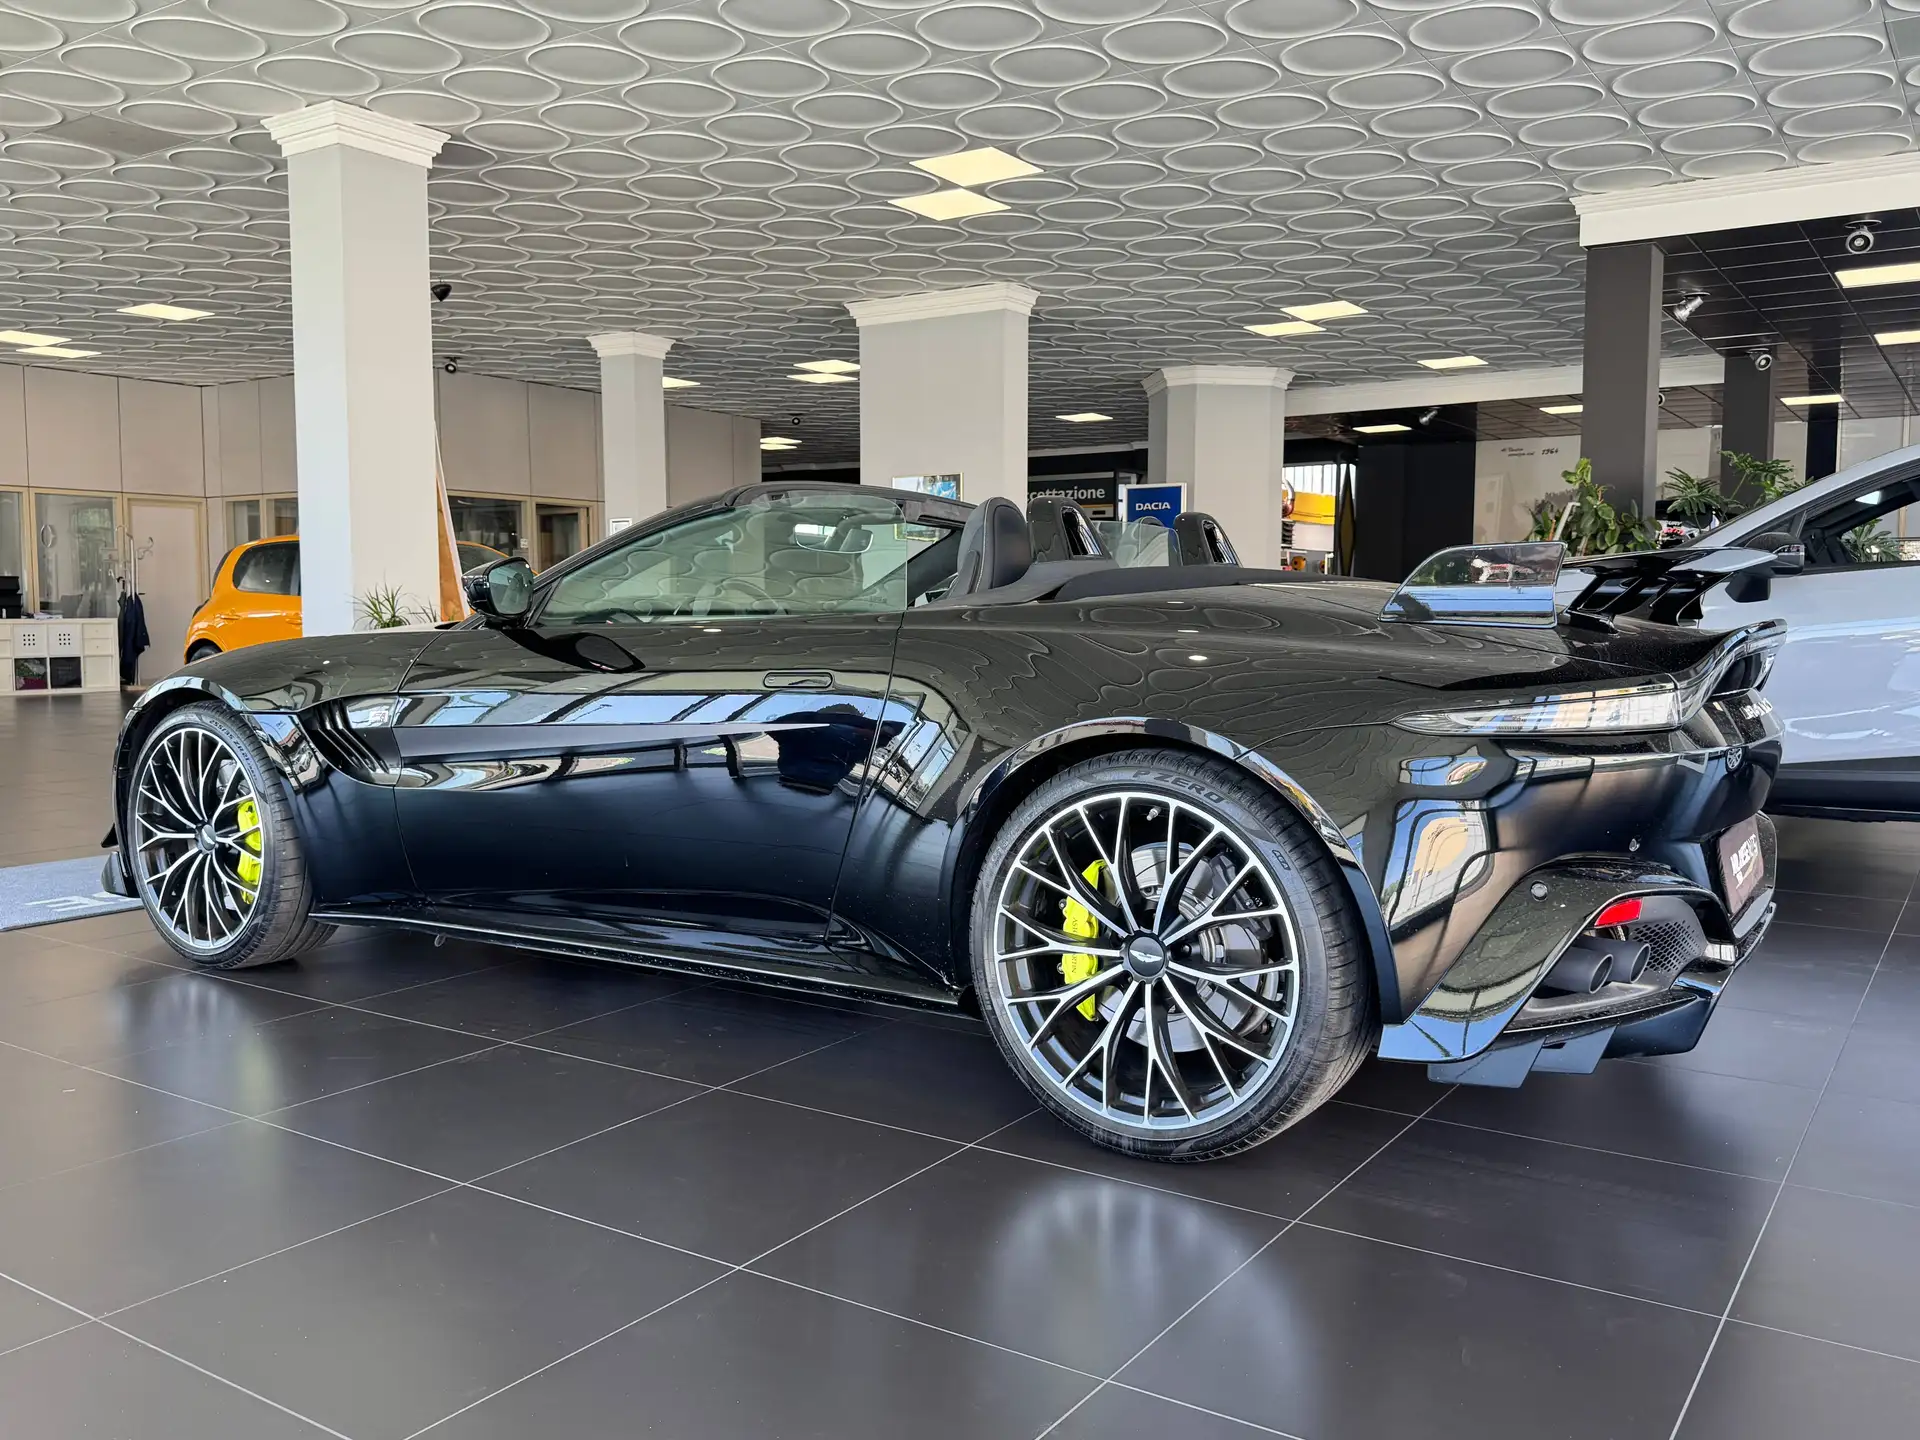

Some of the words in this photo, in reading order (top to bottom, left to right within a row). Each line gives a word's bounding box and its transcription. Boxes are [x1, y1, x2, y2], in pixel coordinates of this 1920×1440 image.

[1027, 485, 1106, 500] cettazione
[1135, 501, 1171, 511] DACIA
[1132, 769, 1151, 778] P
[1153, 772, 1225, 804] ZERO
